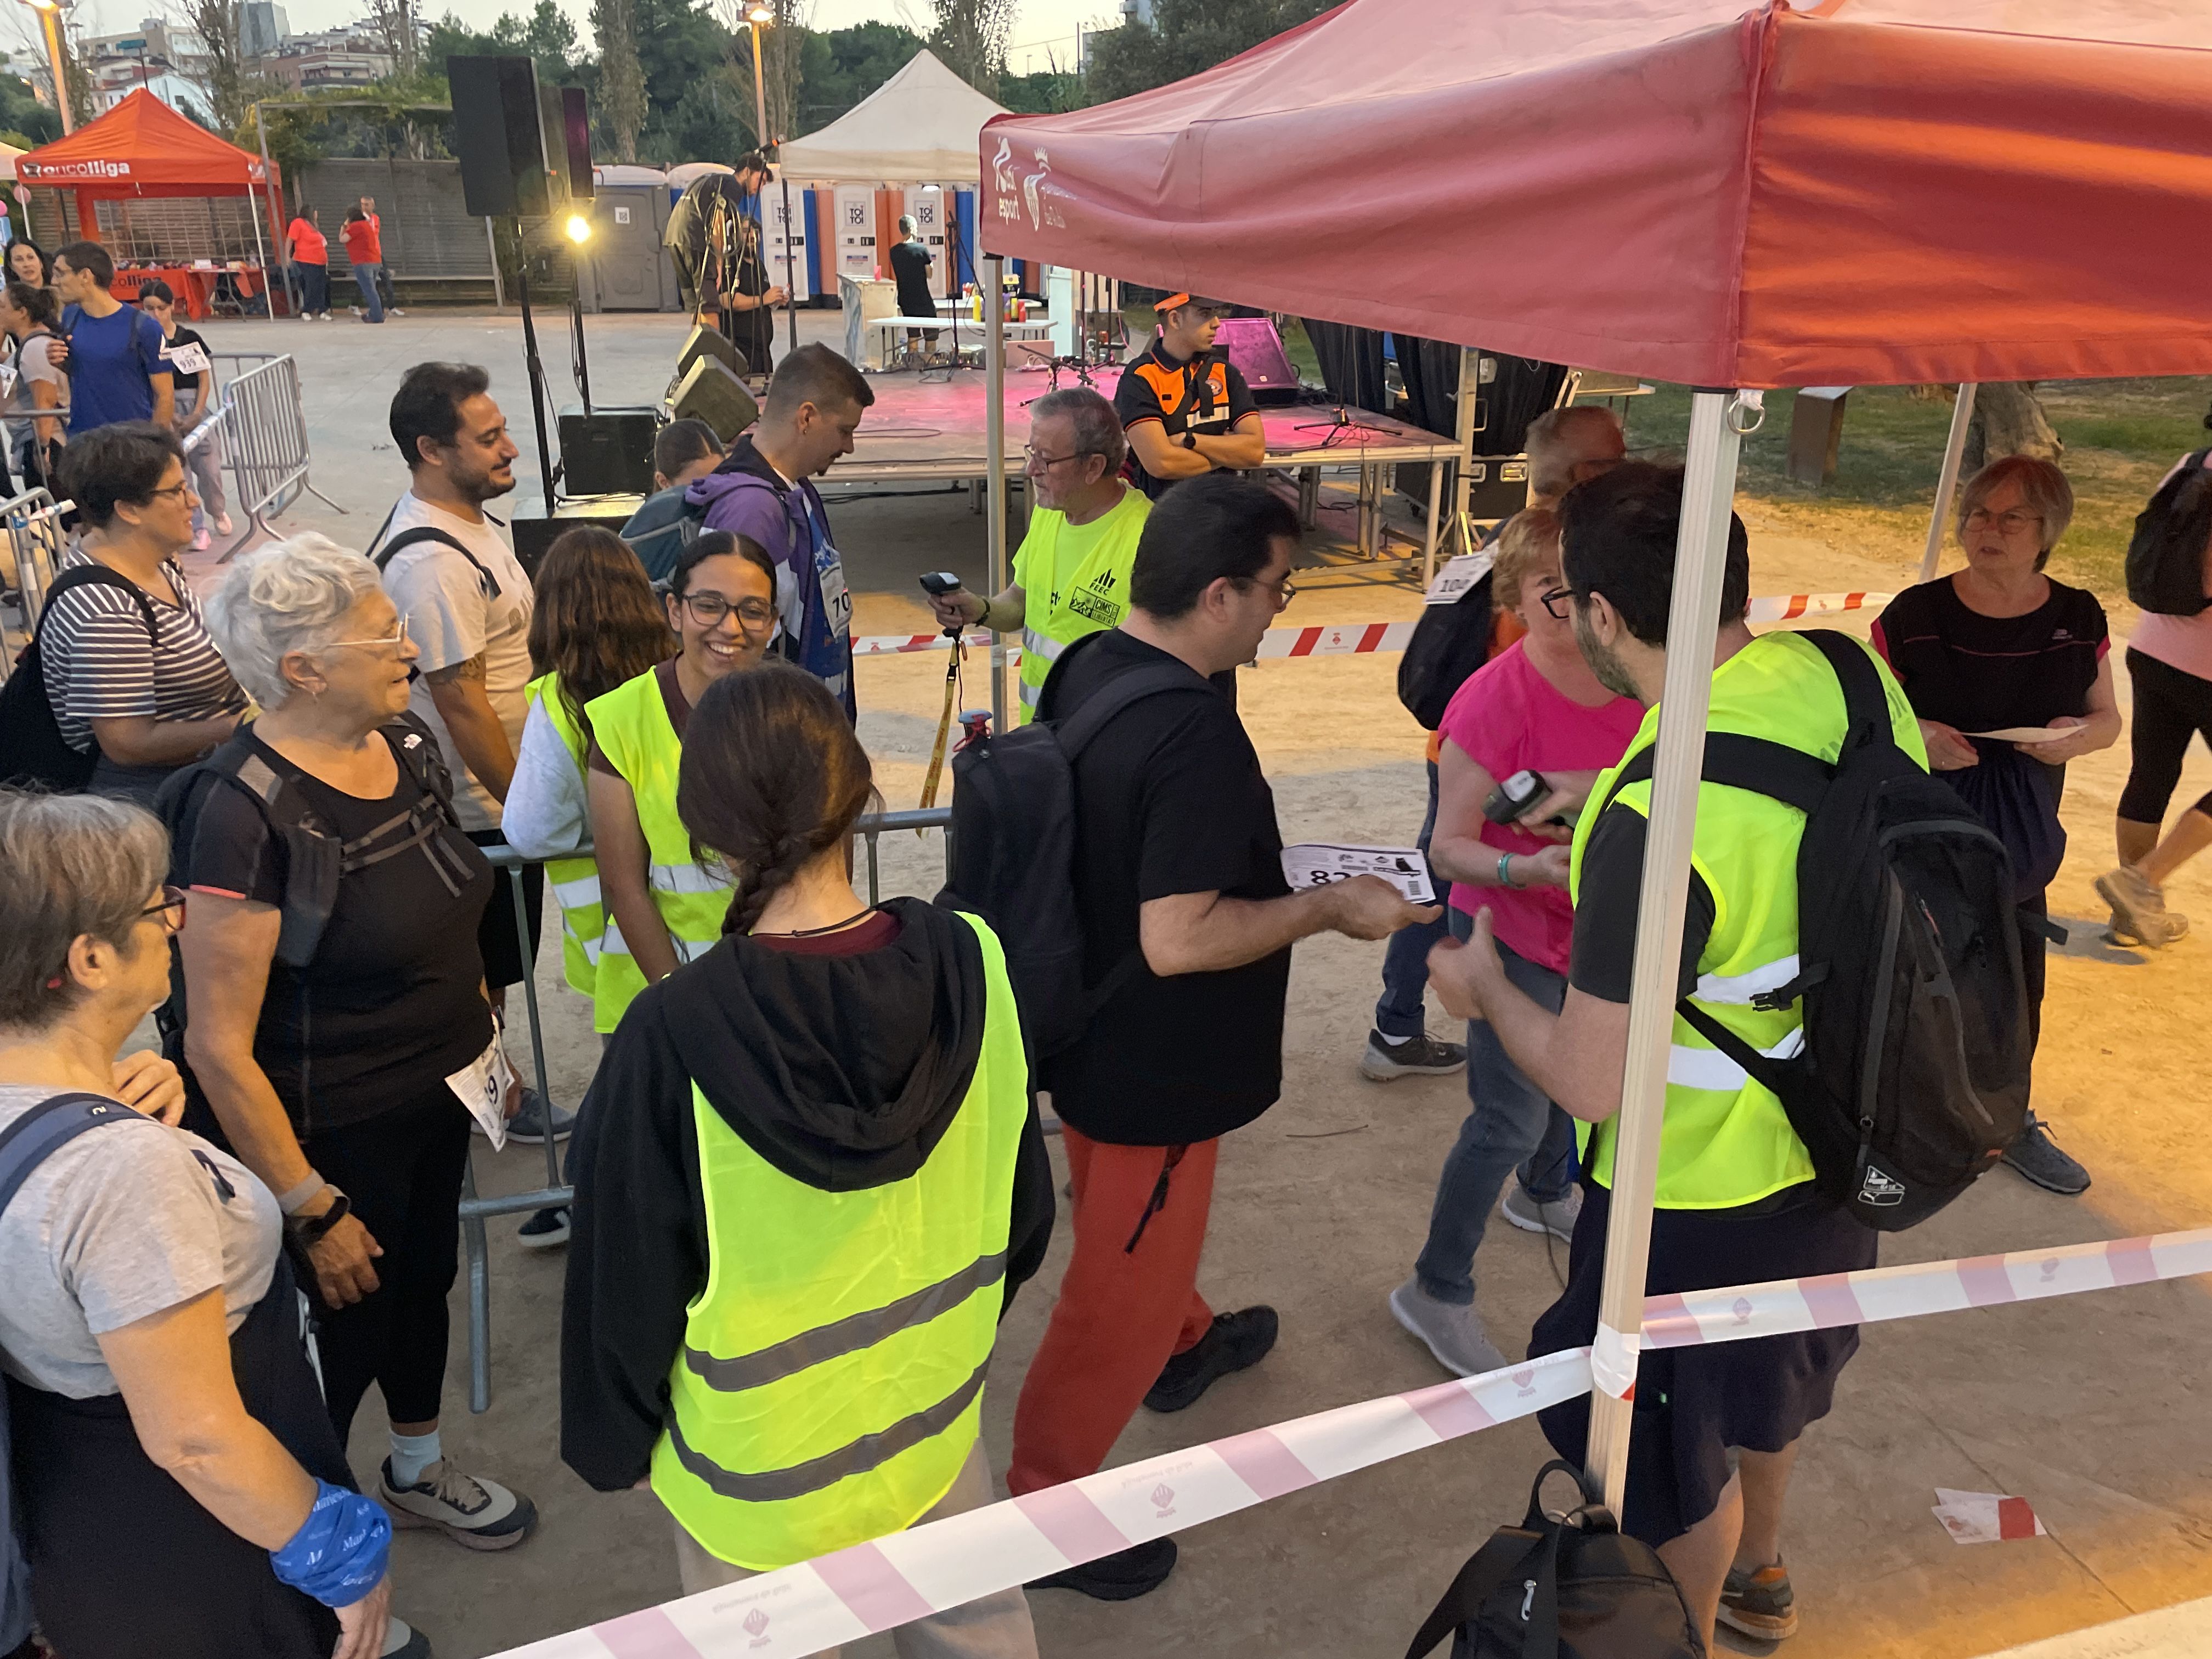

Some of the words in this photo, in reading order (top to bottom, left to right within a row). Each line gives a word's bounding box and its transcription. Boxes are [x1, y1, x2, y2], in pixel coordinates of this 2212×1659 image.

[43, 160, 130, 177] oncolliga
[1089, 582, 1110, 596] FEEC
[1095, 599, 1112, 614] CIMS
